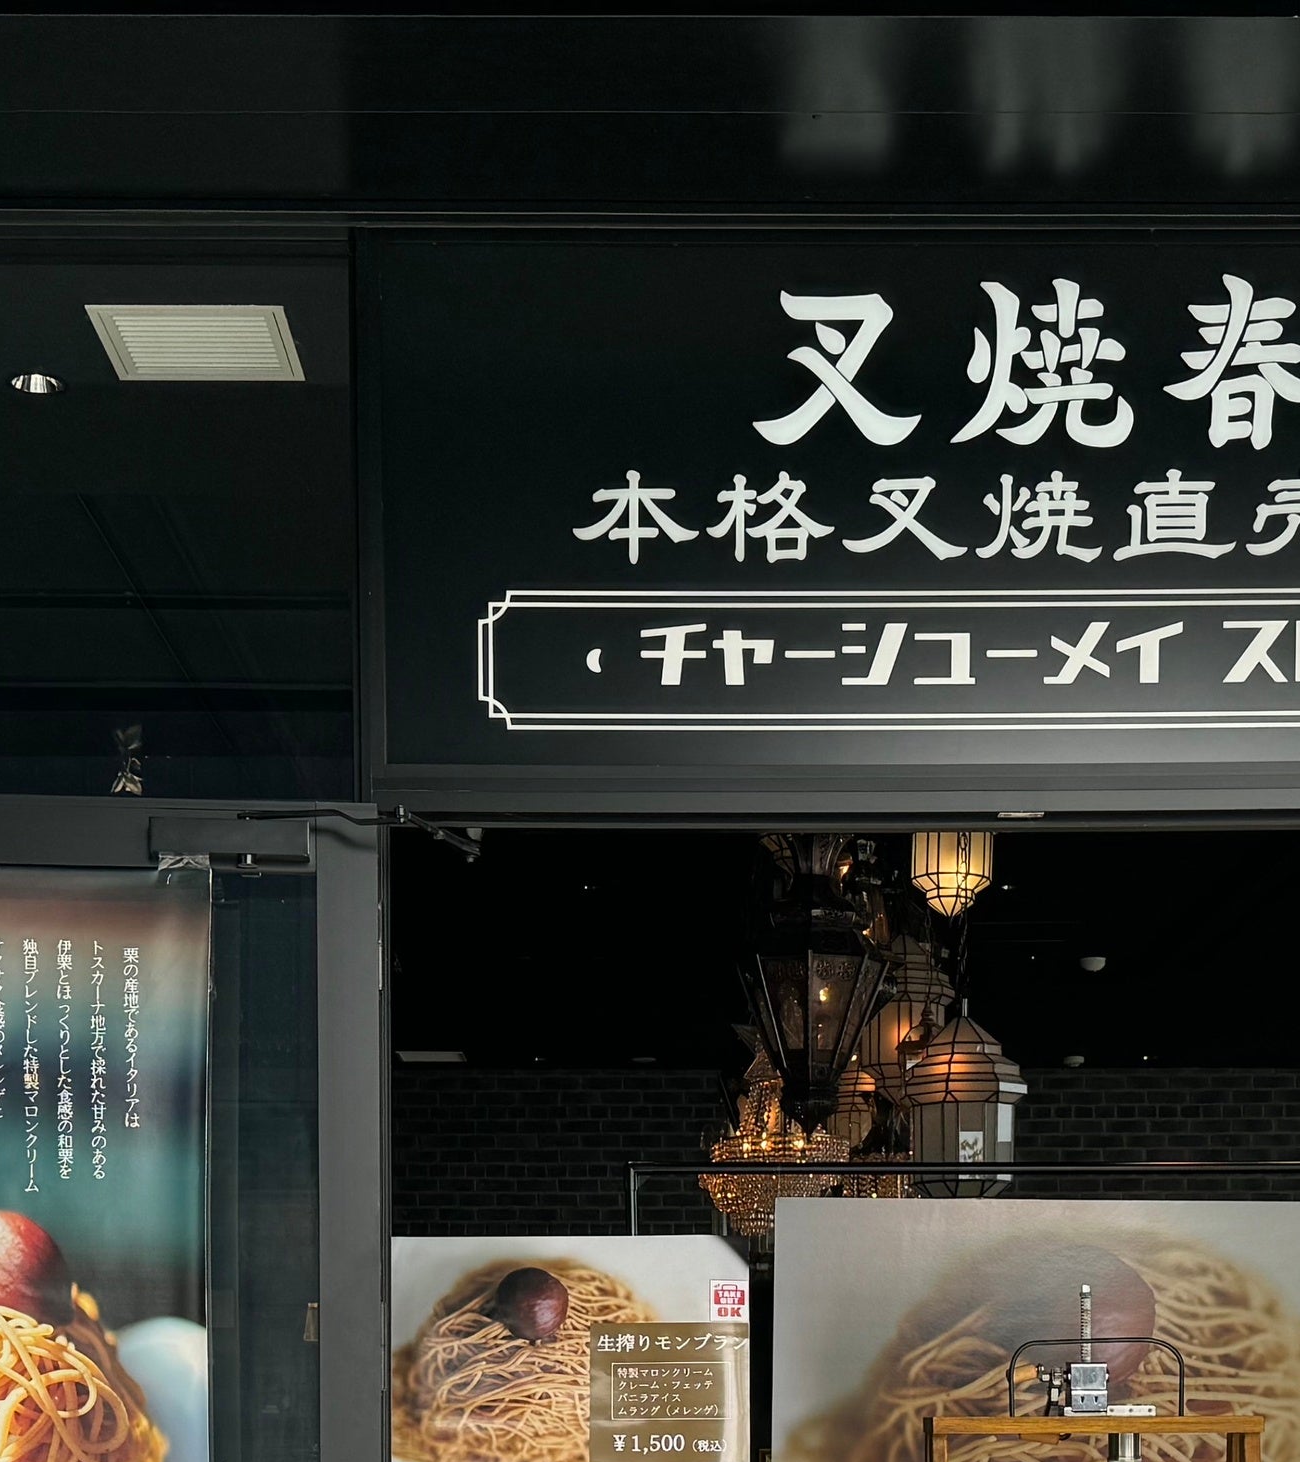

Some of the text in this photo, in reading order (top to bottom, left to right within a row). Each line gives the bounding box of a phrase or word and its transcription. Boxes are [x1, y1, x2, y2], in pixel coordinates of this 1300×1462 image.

[640, 621, 1184, 686] チャーシューメイ
[717, 1307, 741, 1317] OK
[597, 1329, 749, 1355] 生搾りモンブラン
